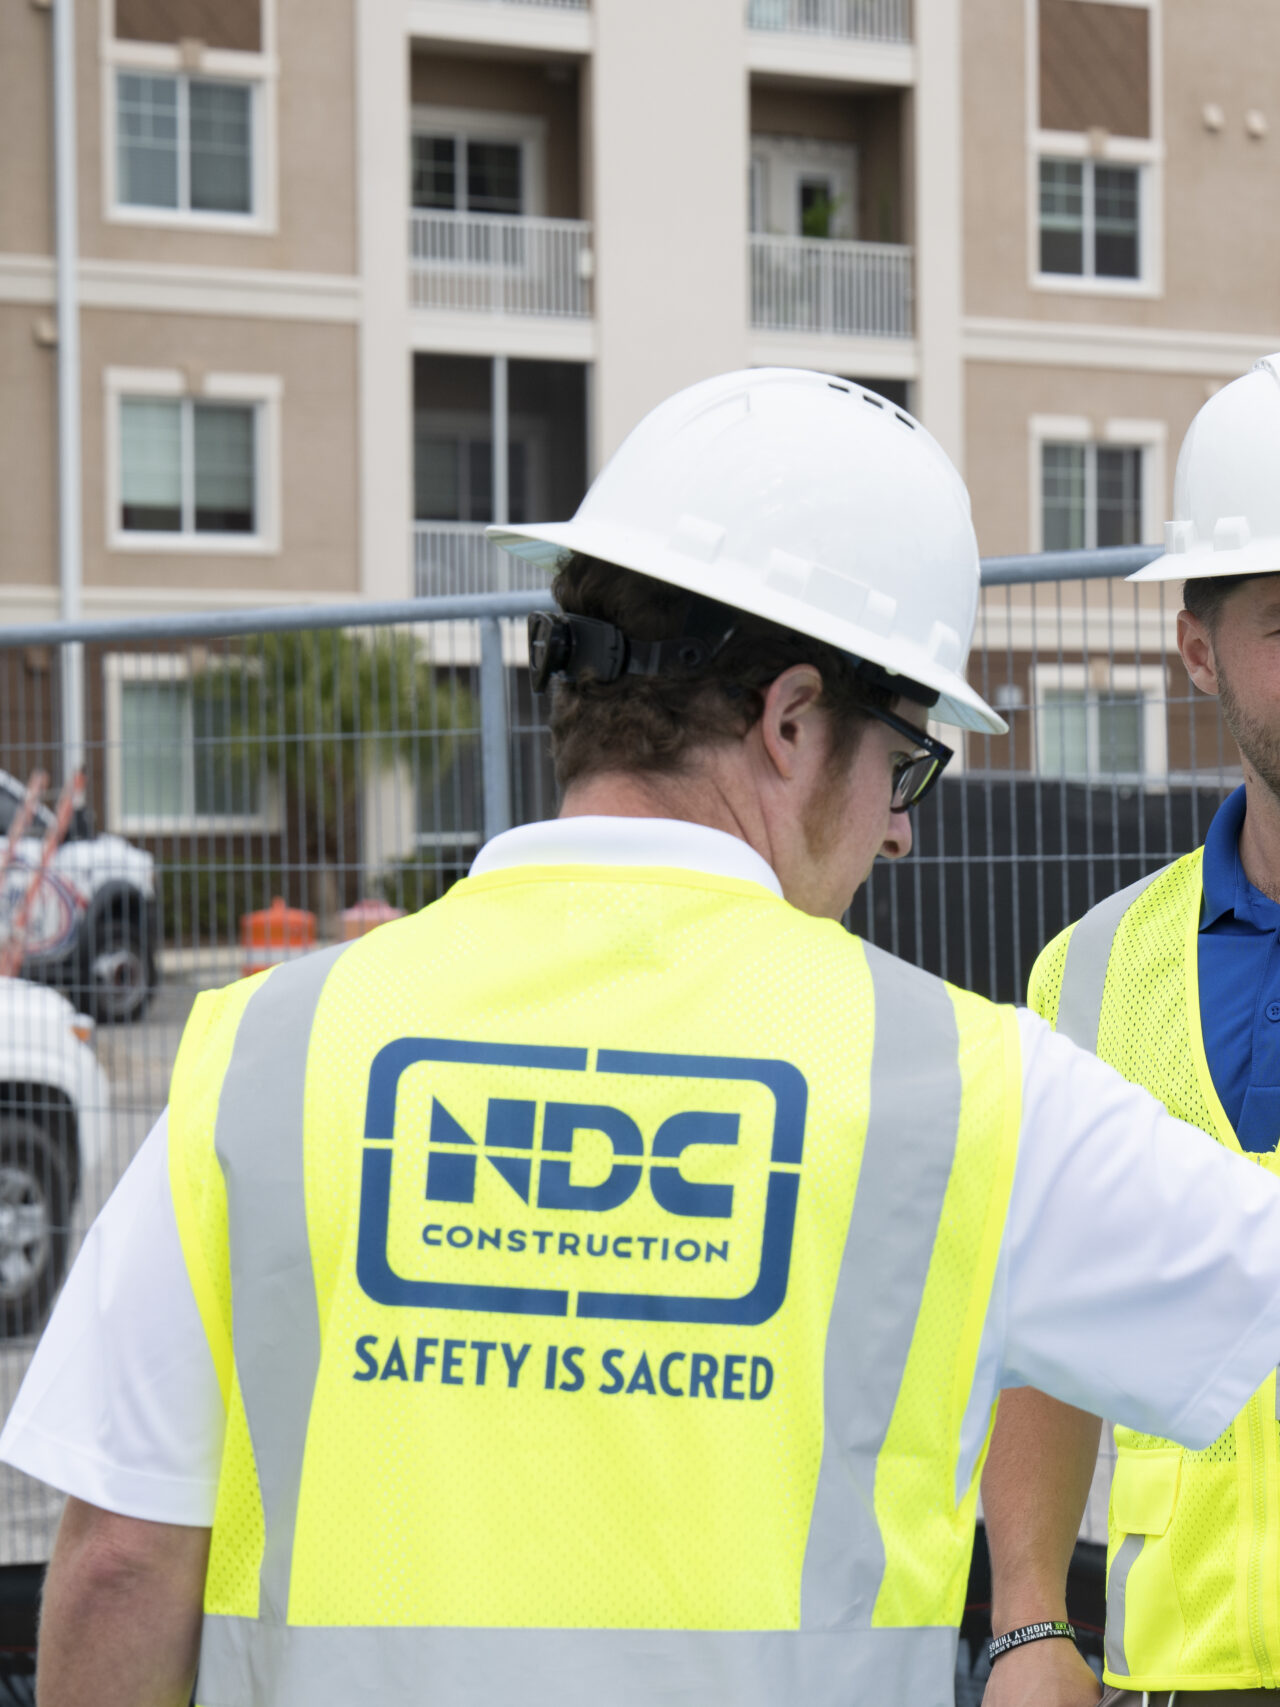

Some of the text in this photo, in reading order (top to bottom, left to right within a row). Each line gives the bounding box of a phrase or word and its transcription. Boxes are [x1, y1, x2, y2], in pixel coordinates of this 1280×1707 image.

[425, 1095, 741, 1219] NDC
[422, 1223, 729, 1264] CONSTRUCTION
[352, 1335, 775, 1400] SAFETY IS SACRED
[989, 1635, 1012, 1652] THINGS
[1014, 1622, 1053, 1639] MIGHTY
